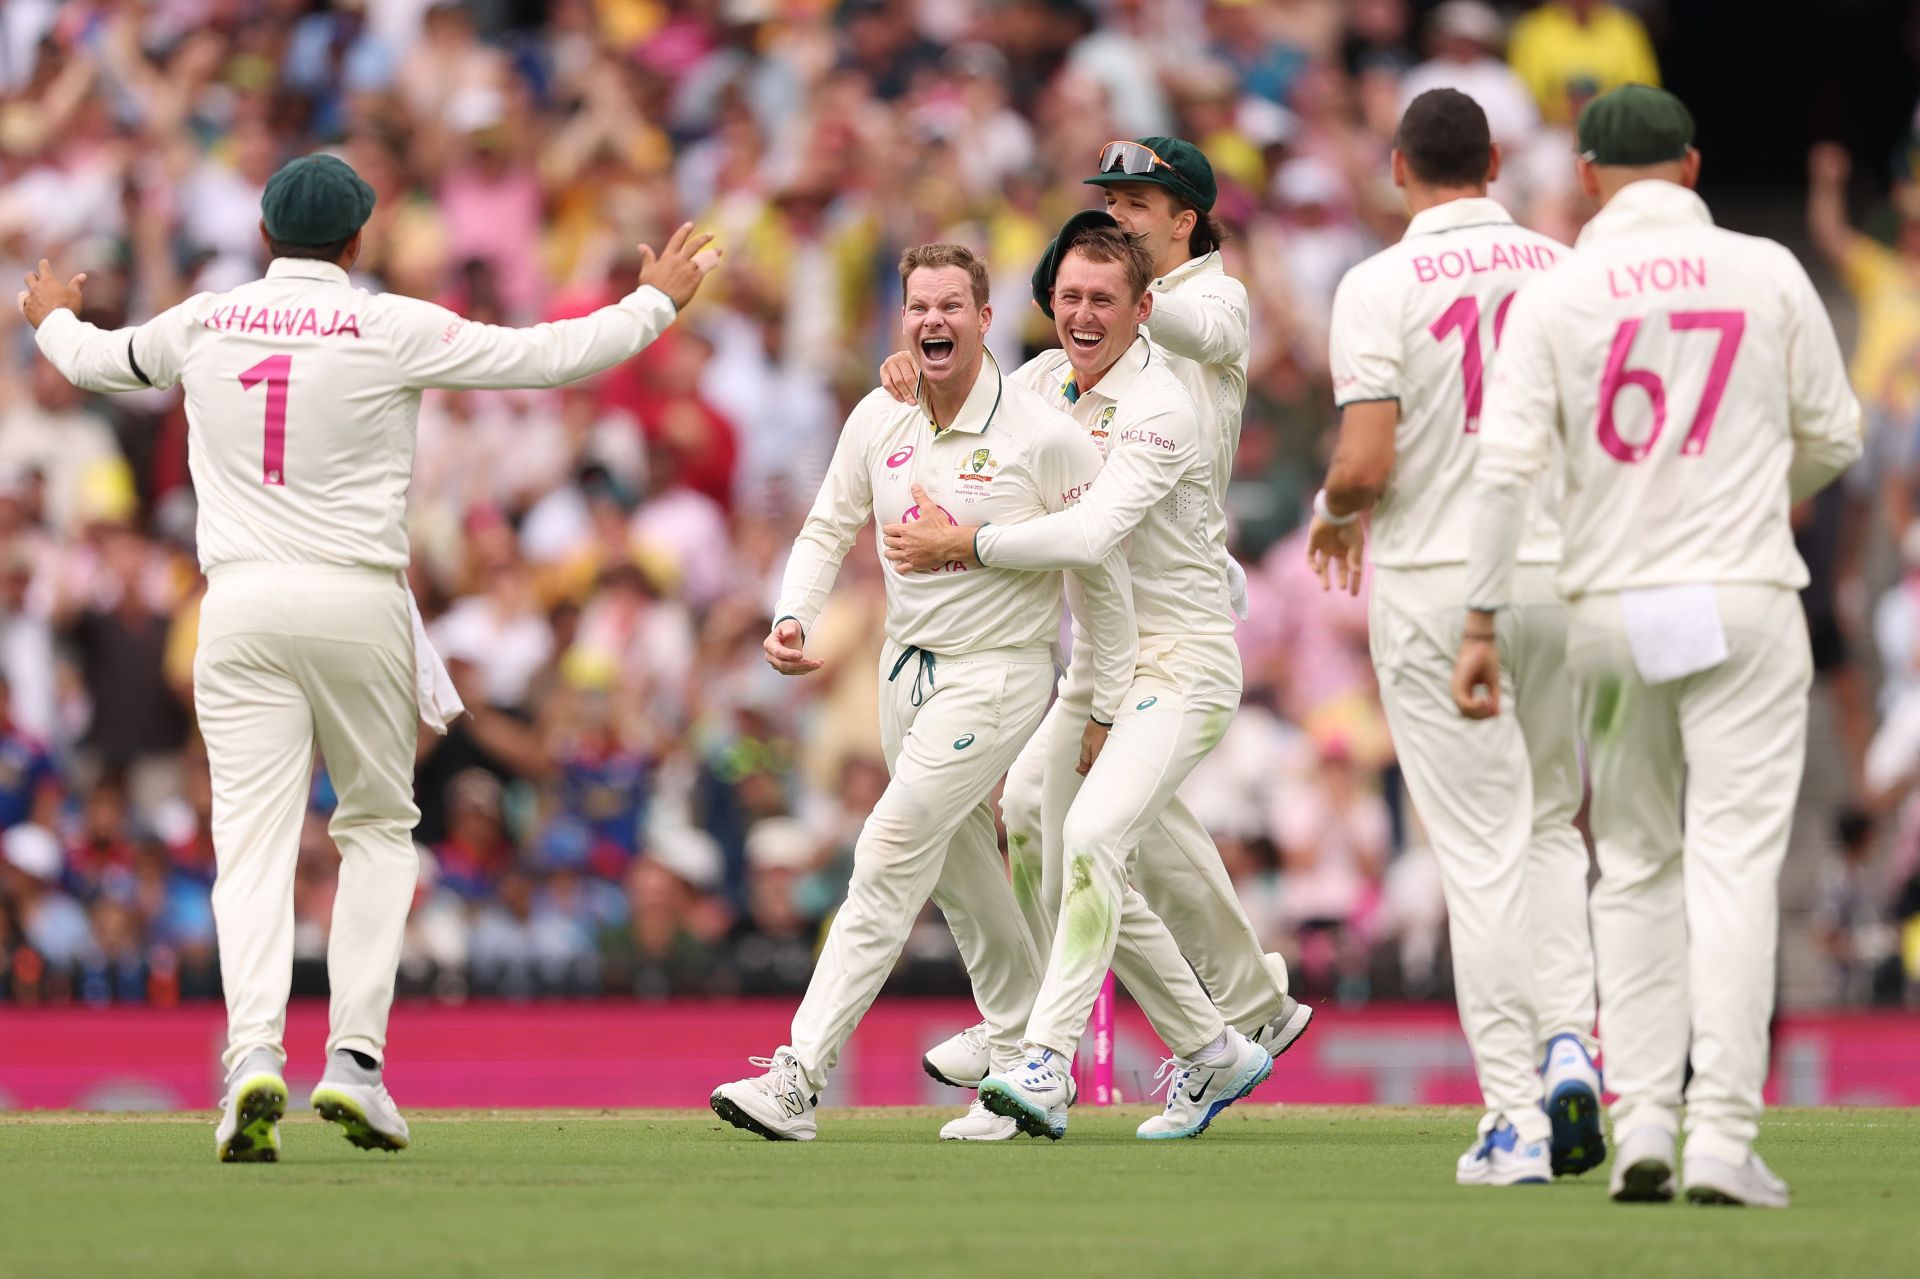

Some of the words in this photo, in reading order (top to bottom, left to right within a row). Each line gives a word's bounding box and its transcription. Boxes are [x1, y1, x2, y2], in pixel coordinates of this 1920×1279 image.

[1412, 243, 1556, 283] BOLAND
[1607, 256, 1706, 299] LYON
[205, 304, 361, 339] KHAWAJA
[1429, 289, 1518, 434] 1
[1596, 309, 1746, 464] 67
[237, 354, 292, 486] 1
[1120, 429, 1176, 453] HCLTech
